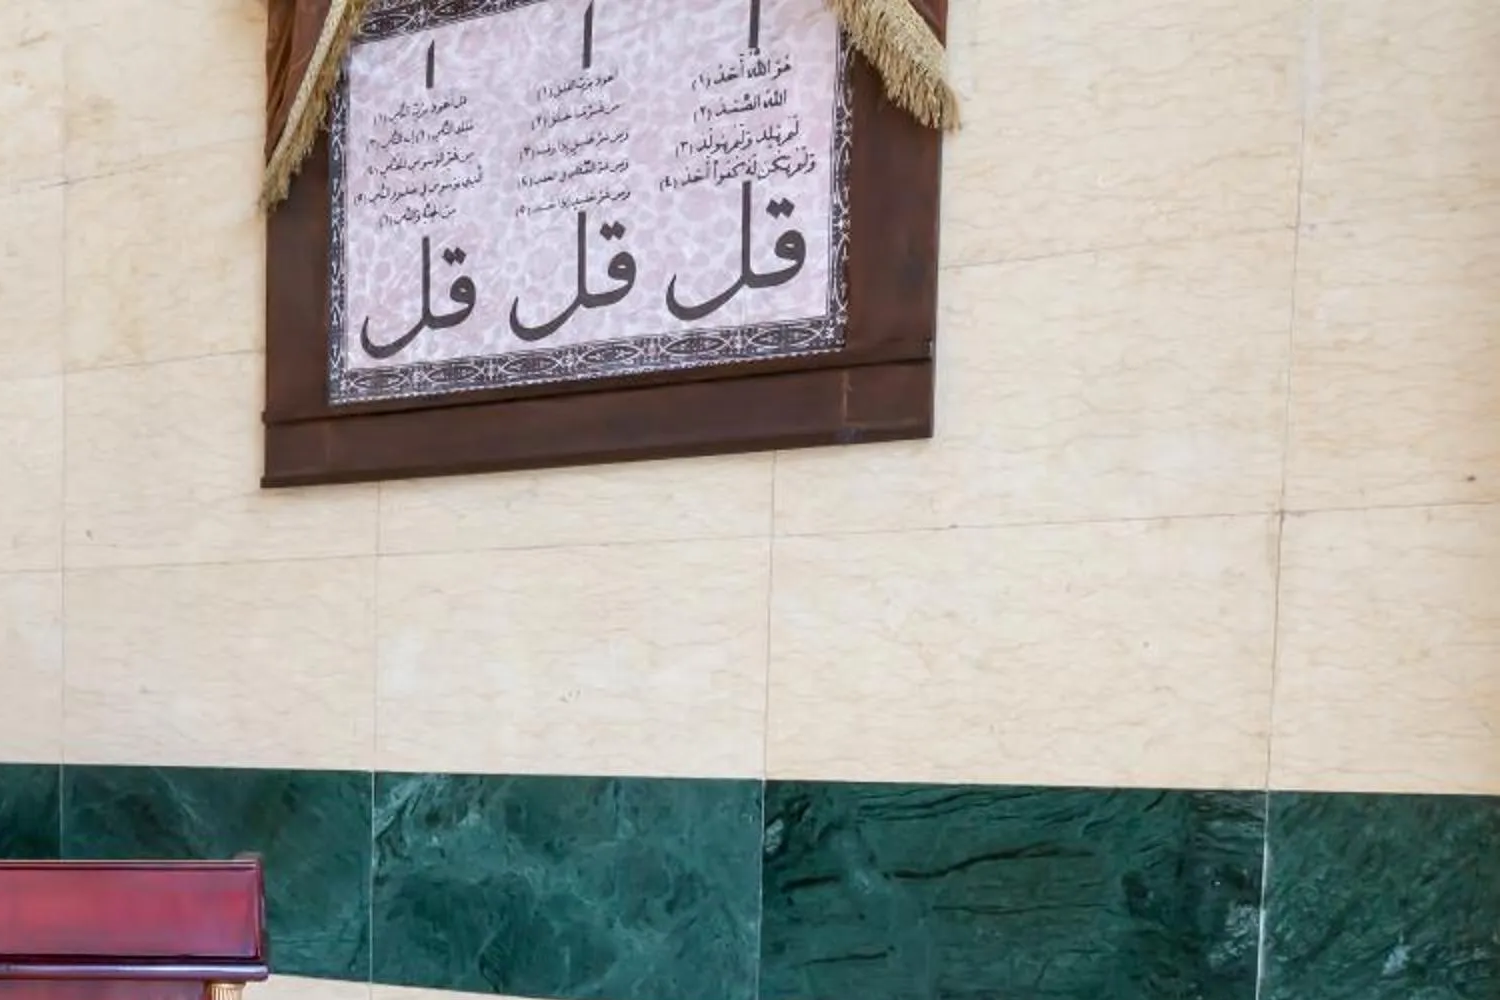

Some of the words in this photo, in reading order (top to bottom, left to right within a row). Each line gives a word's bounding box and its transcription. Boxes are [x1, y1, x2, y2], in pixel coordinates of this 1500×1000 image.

[361, 236, 477, 358] قل
[509, 211, 637, 341] قل
[666, 181, 807, 320] قل
